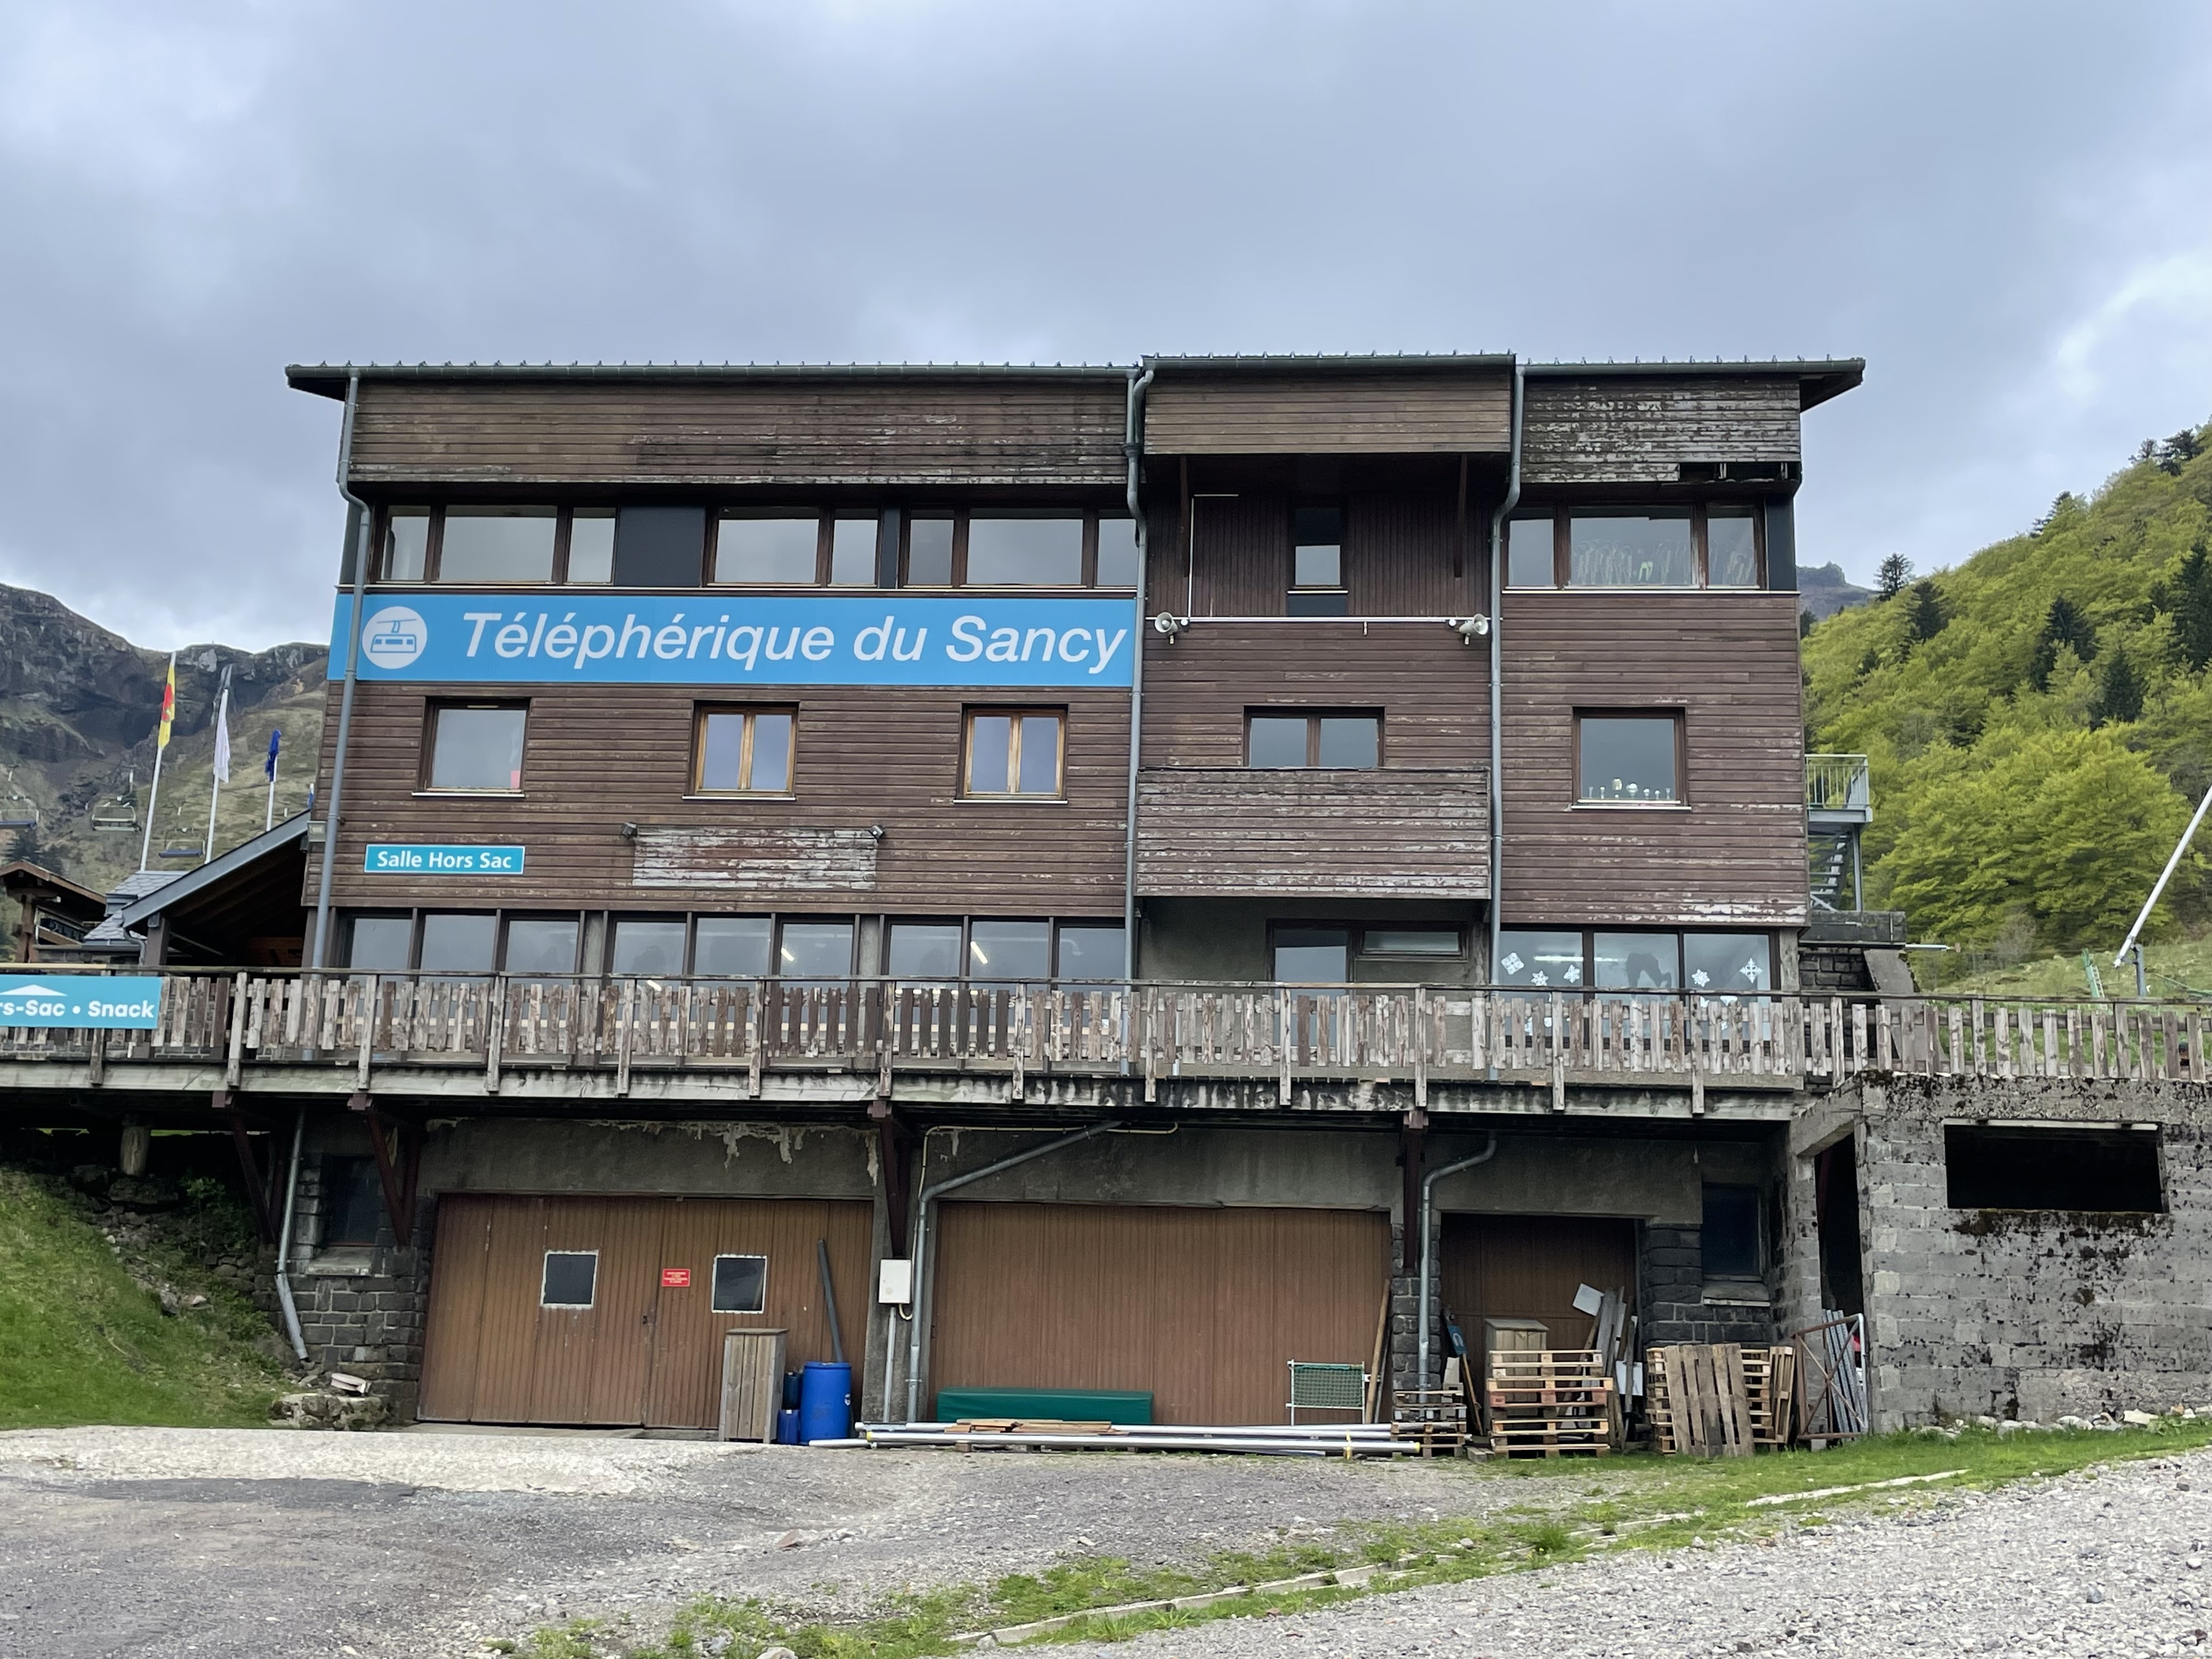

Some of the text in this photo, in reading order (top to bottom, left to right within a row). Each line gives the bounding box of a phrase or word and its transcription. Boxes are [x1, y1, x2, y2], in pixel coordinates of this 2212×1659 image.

[463, 612, 1127, 675] Téléphérique du Sancy
[377, 850, 512, 868] Salle Hors Sac
[87, 1000, 155, 1018] Snack
